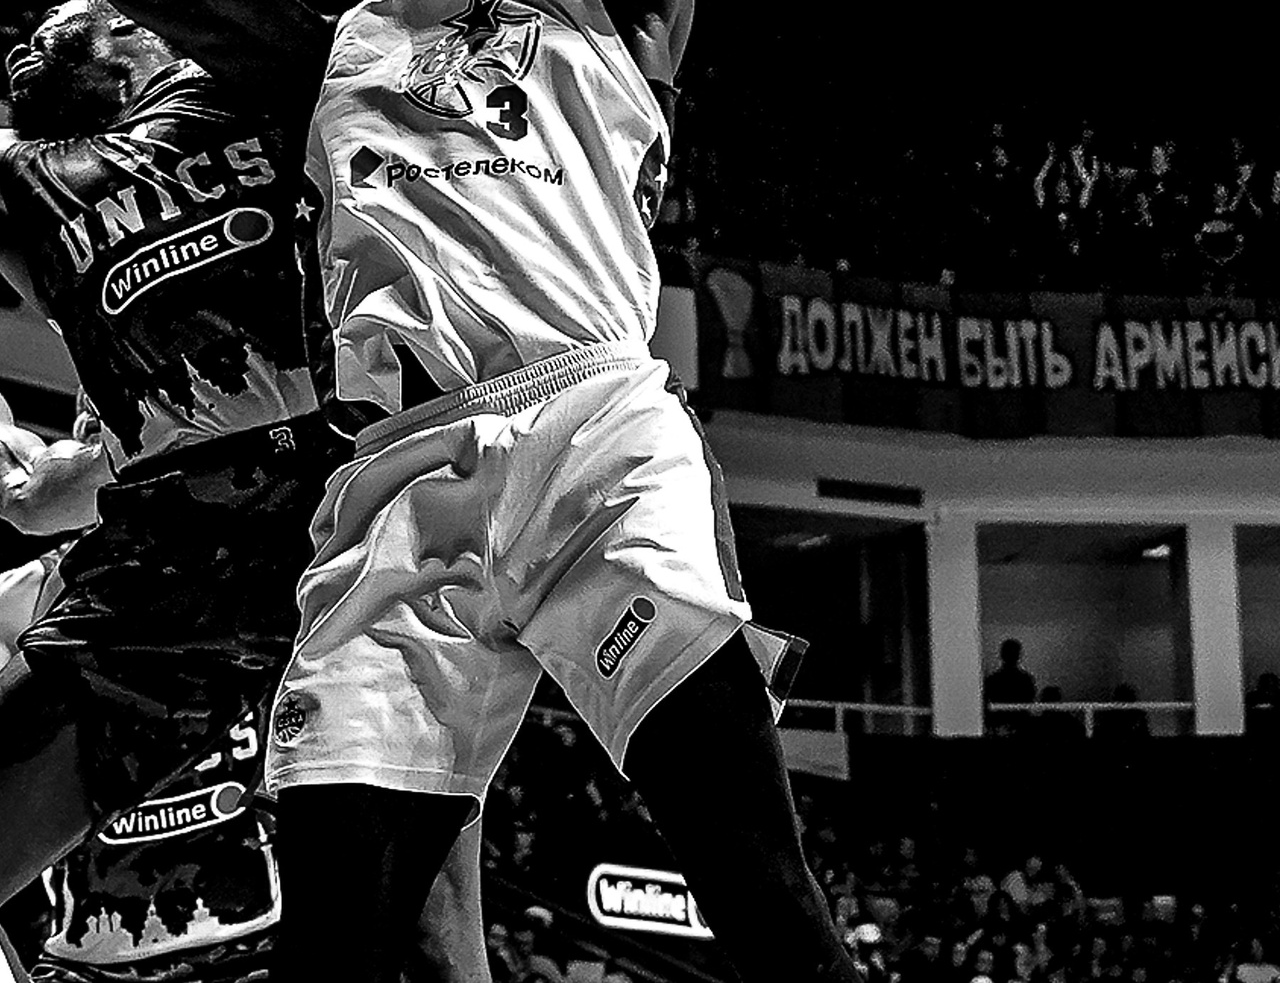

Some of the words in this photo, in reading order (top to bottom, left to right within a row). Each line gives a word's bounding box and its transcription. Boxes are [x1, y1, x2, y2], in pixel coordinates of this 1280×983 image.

[485, 84, 528, 141] 3
[776, 294, 946, 383] ДОЛЖЕН
[957, 316, 1072, 388] БЫТЬ
